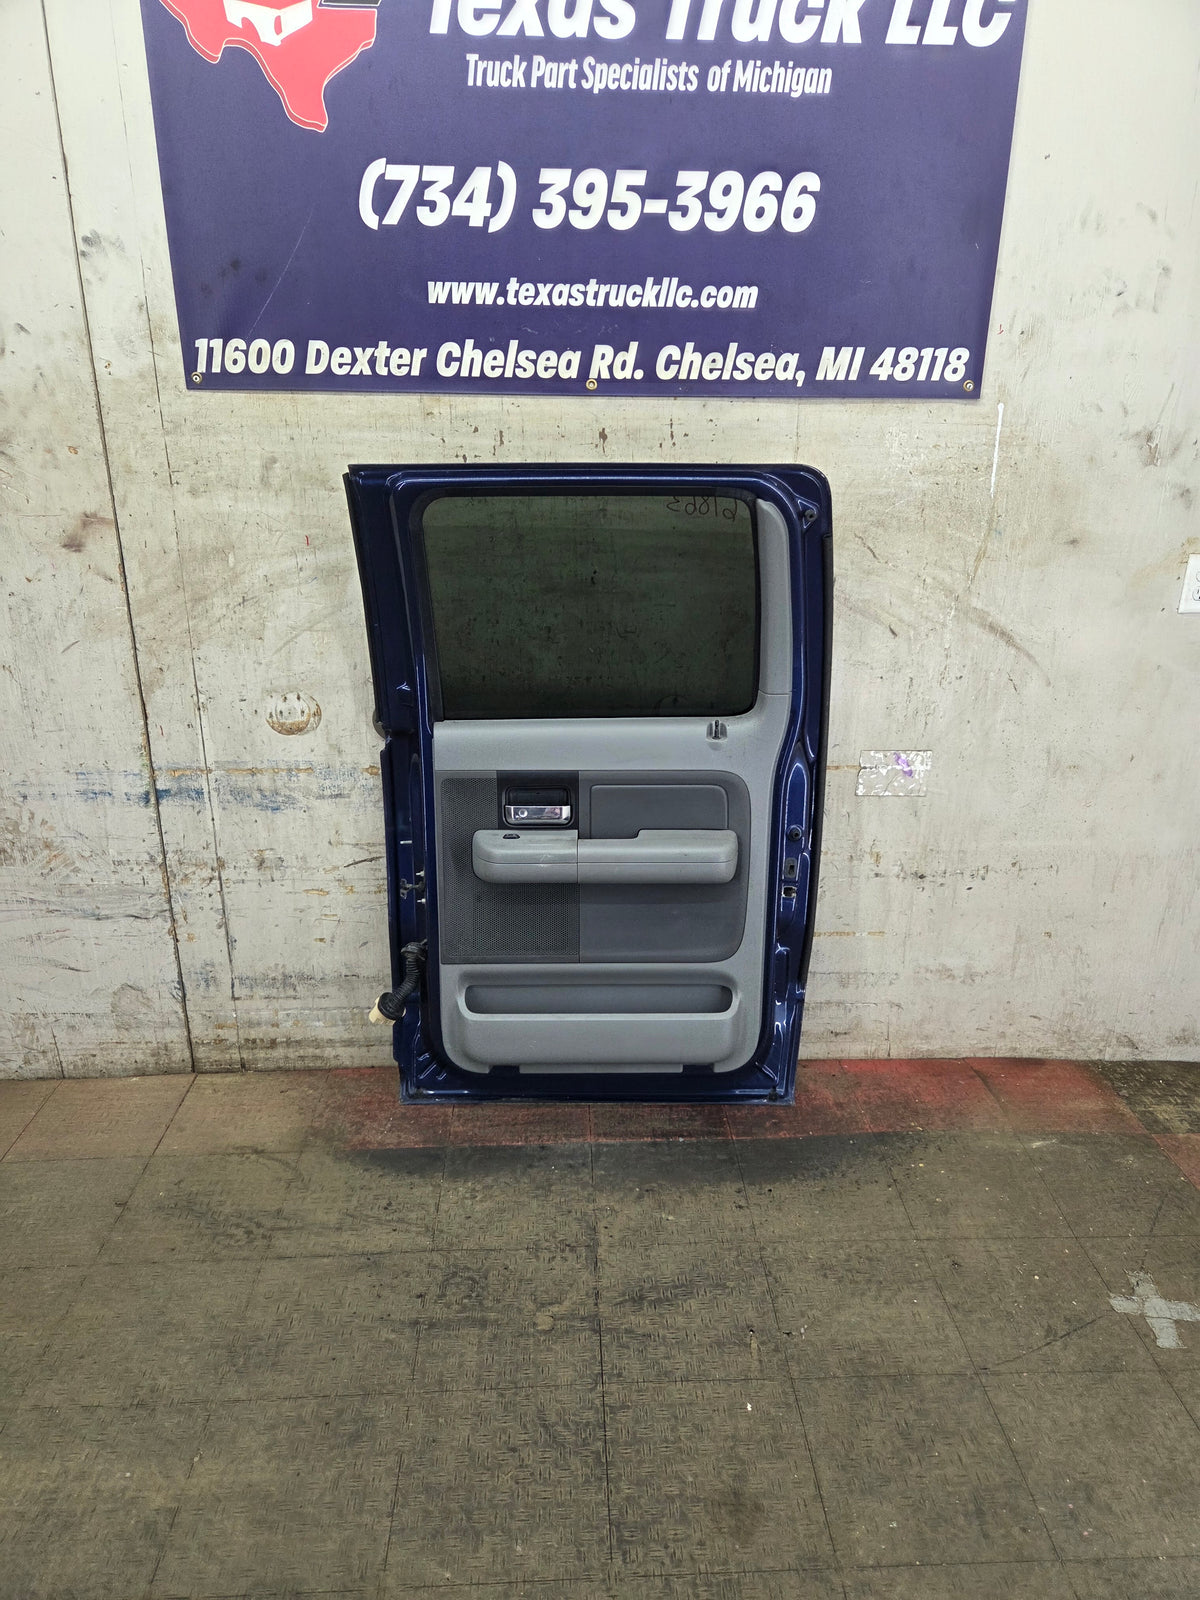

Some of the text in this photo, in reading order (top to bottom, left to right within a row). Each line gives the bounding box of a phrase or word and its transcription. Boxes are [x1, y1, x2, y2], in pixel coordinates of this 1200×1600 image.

[885, 0, 1013, 48] LLC
[466, 53, 832, 98] Truck Part Specialists of Michigan
[359, 158, 820, 233] (734) 395-3966
[428, 277, 758, 308] www.texastruckllc.com
[194, 339, 969, 387] 11600 Dexter Chelsea Rd. Chelsea, MI 48118
